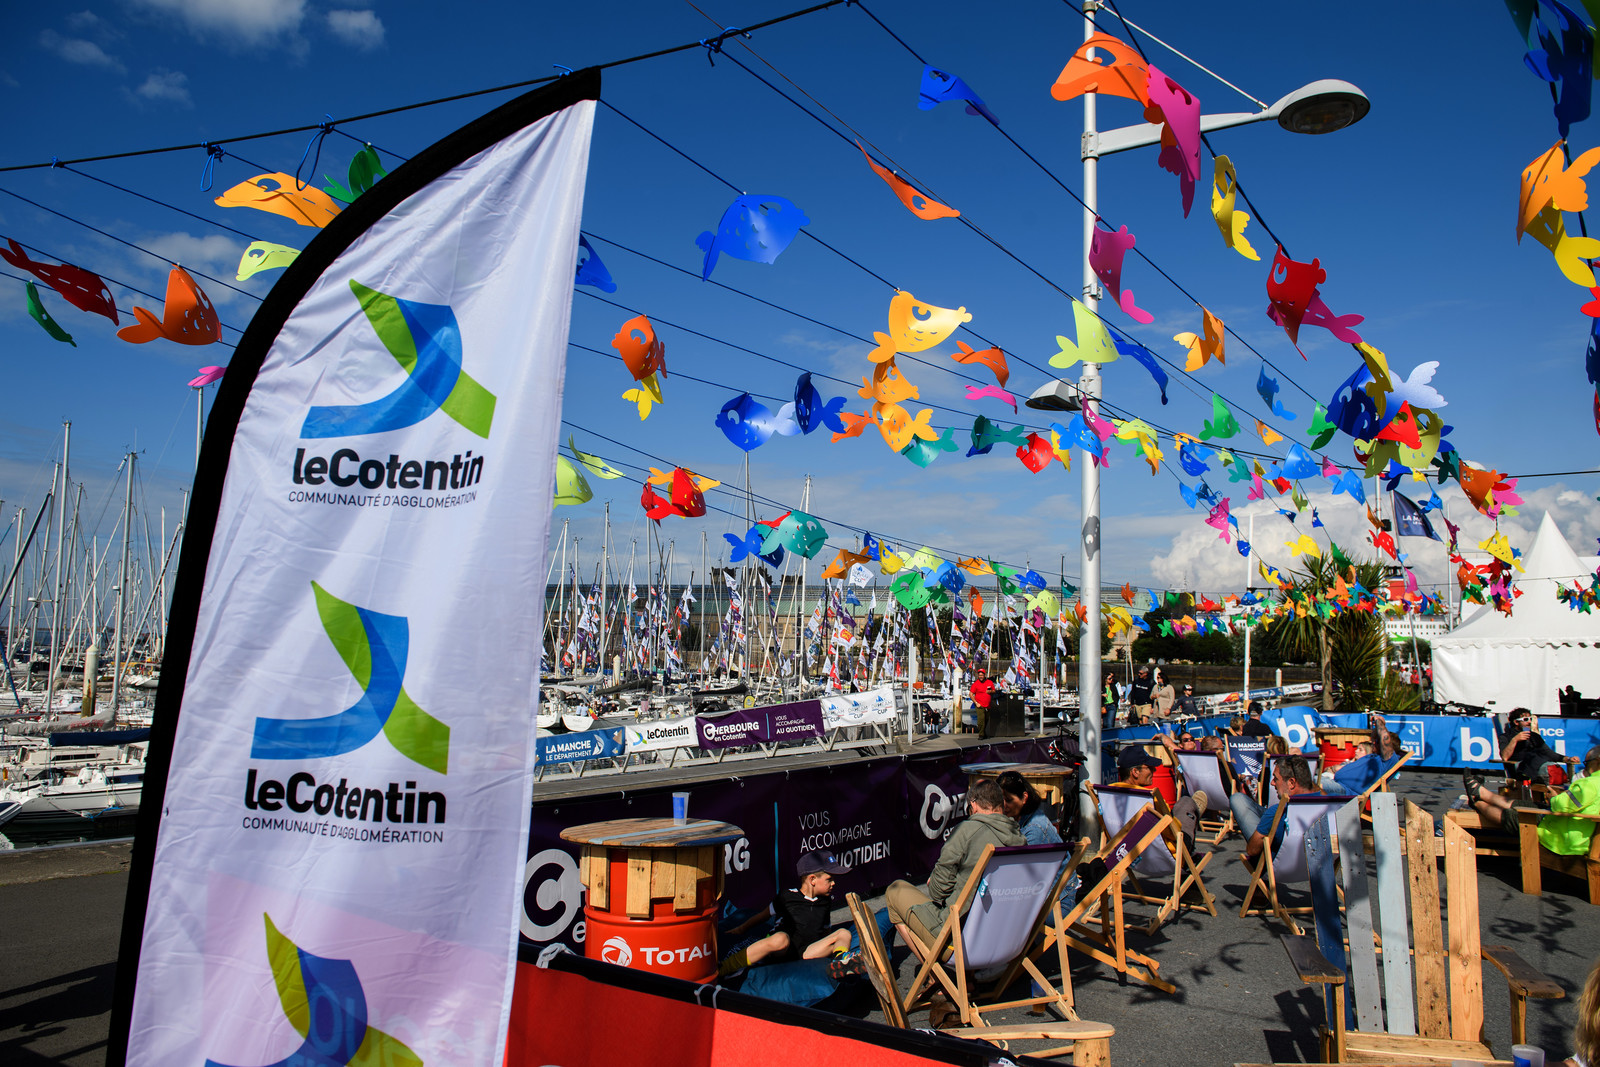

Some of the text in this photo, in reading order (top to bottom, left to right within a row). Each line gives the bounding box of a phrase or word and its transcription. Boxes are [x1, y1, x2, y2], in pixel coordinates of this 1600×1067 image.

[292, 447, 484, 491] leCotentin
[288, 490, 477, 509] COMMUNAUTÉ D'AGGLOMÉRATION
[647, 725, 689, 740] leCotentin
[703, 721, 760, 740] CHERBOURG
[722, 732, 747, 741] Cotentin
[786, 724, 816, 733] QUOTIDIEN
[545, 740, 592, 754] LA MANCHE
[554, 750, 592, 761] DÉPARTEMENT
[244, 768, 447, 824] leCotentin
[242, 816, 443, 843] COMMUNAUTÉ D'AGGLOMÉRATION
[799, 810, 830, 831] VOUS
[800, 821, 872, 853] ACCOMPAGNE
[640, 943, 711, 966] TOTAL
